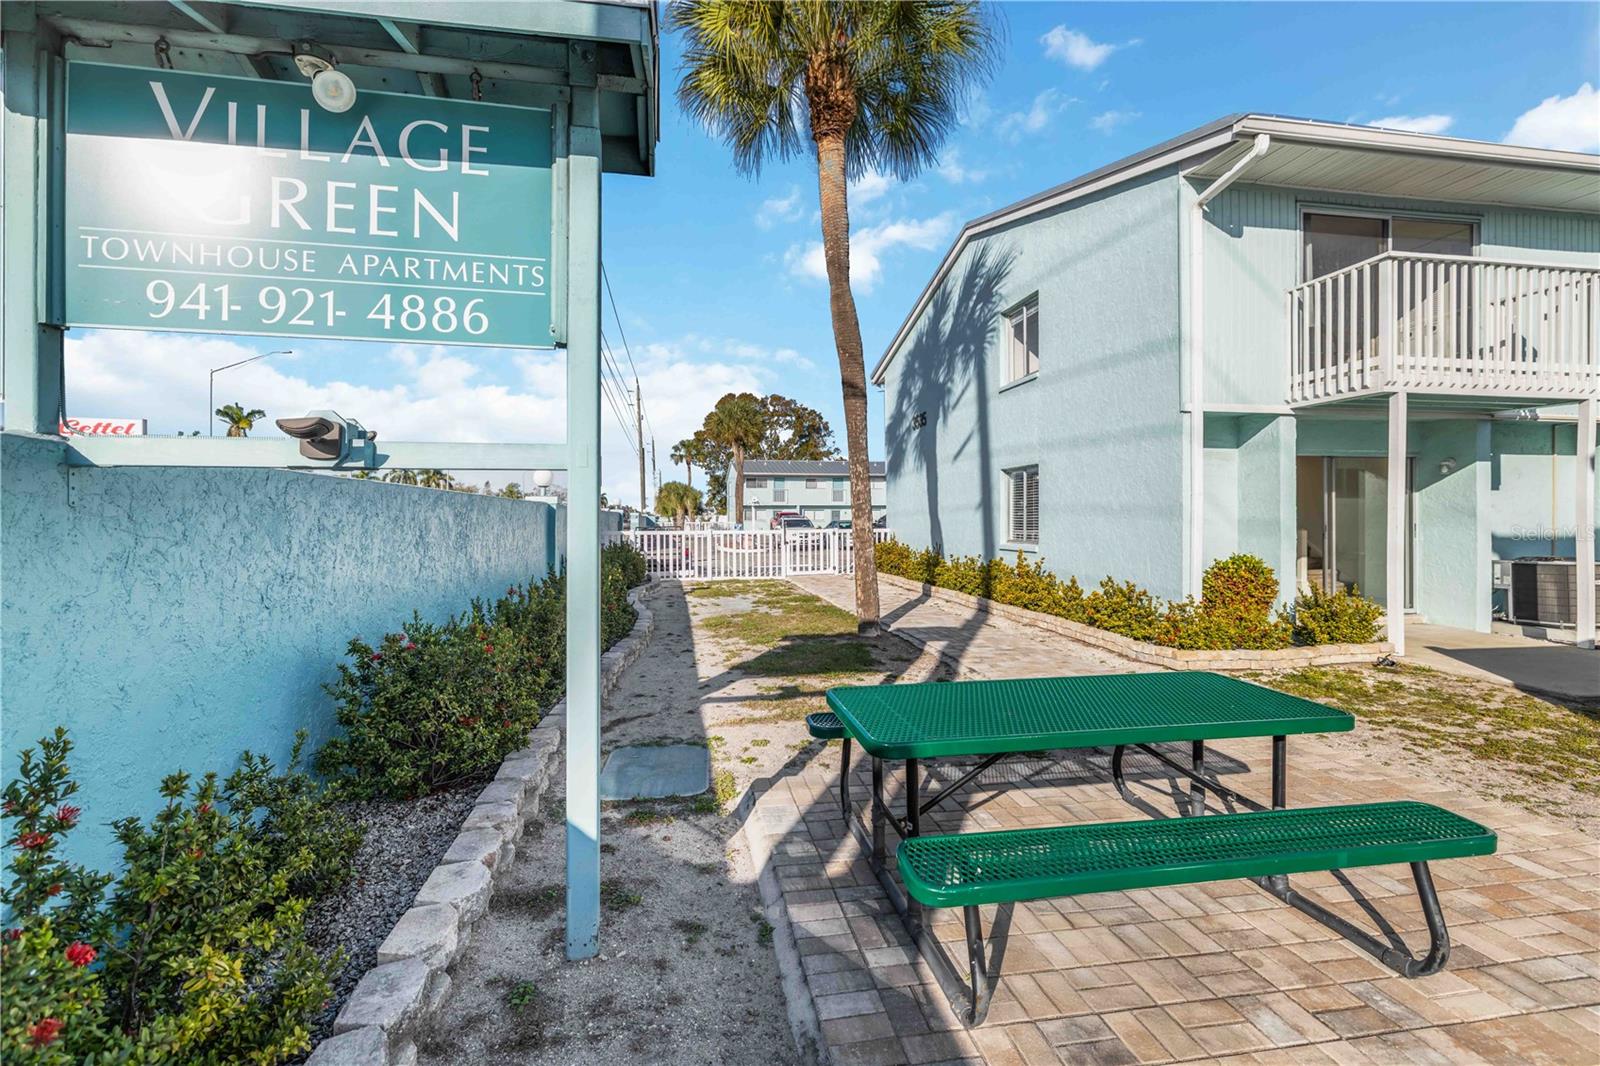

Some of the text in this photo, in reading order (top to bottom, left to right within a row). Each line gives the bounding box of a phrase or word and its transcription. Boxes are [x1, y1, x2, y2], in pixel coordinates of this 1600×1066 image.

[149, 81, 490, 176] VILLAGE
[79, 235, 546, 288] TOWNHOUSE APARTMENTS
[367, 293, 490, 335] 4886
